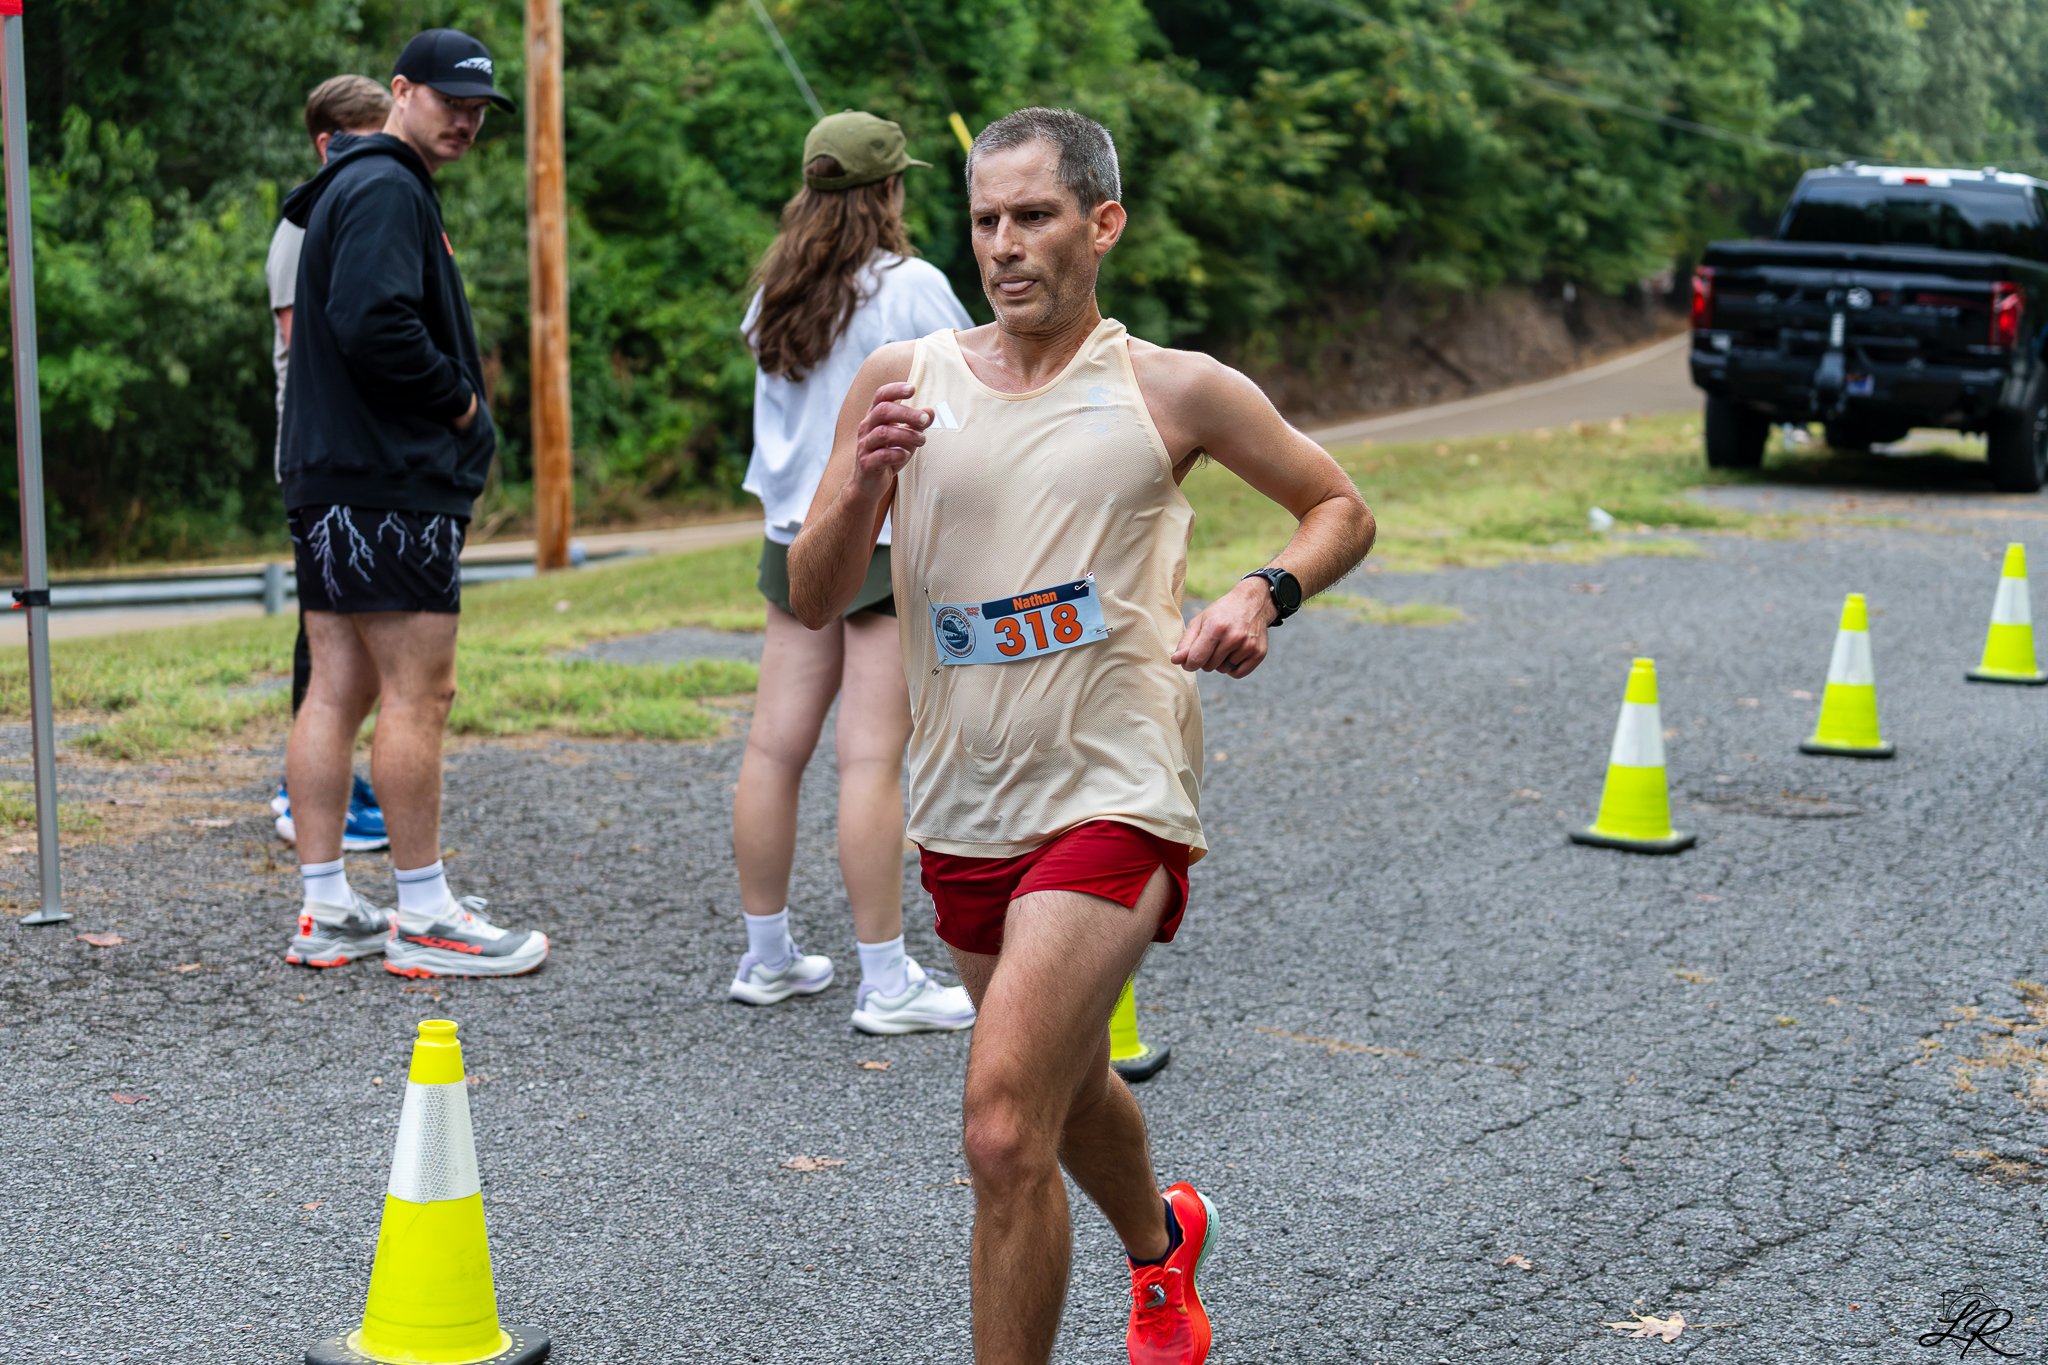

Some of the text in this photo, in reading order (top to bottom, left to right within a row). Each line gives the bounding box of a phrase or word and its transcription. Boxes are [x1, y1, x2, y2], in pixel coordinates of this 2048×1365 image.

[1012, 590, 1058, 612] Nathan
[994, 603, 1083, 657] 318
[404, 936, 484, 955] ALTRA
